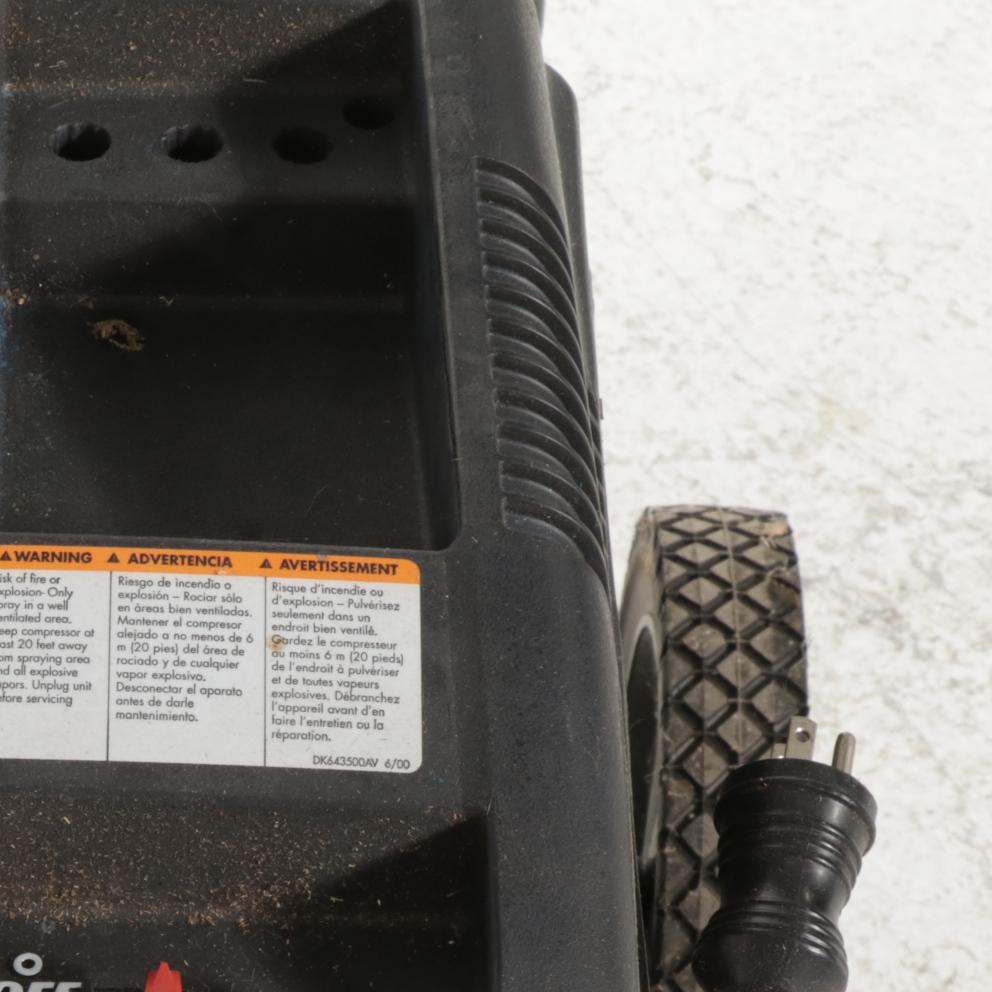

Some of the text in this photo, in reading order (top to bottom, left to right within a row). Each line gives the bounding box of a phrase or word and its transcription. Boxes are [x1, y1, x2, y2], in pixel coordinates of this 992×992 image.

[15, 551, 92, 563] WARNING
[127, 553, 233, 569] ADVERTENCIA
[280, 559, 399, 575] AVERTISSEMENT
[16, 573, 26, 584] of
[30, 573, 46, 584] fire
[49, 576, 60, 585] or
[48, 587, 73, 600] Only
[24, 601, 33, 610] in
[37, 603, 44, 611] a
[48, 600, 69, 611] well
[272, 609, 324, 620] seulement
[328, 611, 354, 621] dans
[117, 616, 242, 630] Mantener el compresor
[272, 623, 309, 632] endroit
[313, 623, 336, 634] bien
[21, 629, 80, 640] compressor
[84, 629, 94, 638] at
[18, 640, 33, 649] 20
[36, 640, 55, 650] feet
[58, 642, 87, 653] away
[17, 654, 62, 666] spraying
[66, 656, 90, 664] area
[14, 666, 26, 676] all
[30, 668, 78, 680] explosive
[32, 681, 69, 693] Unplug
[73, 682, 92, 692] unit
[116, 682, 243, 698] Desconectar el aparato
[328, 705, 357, 715] avant
[116, 711, 198, 722] mantenimiento.
